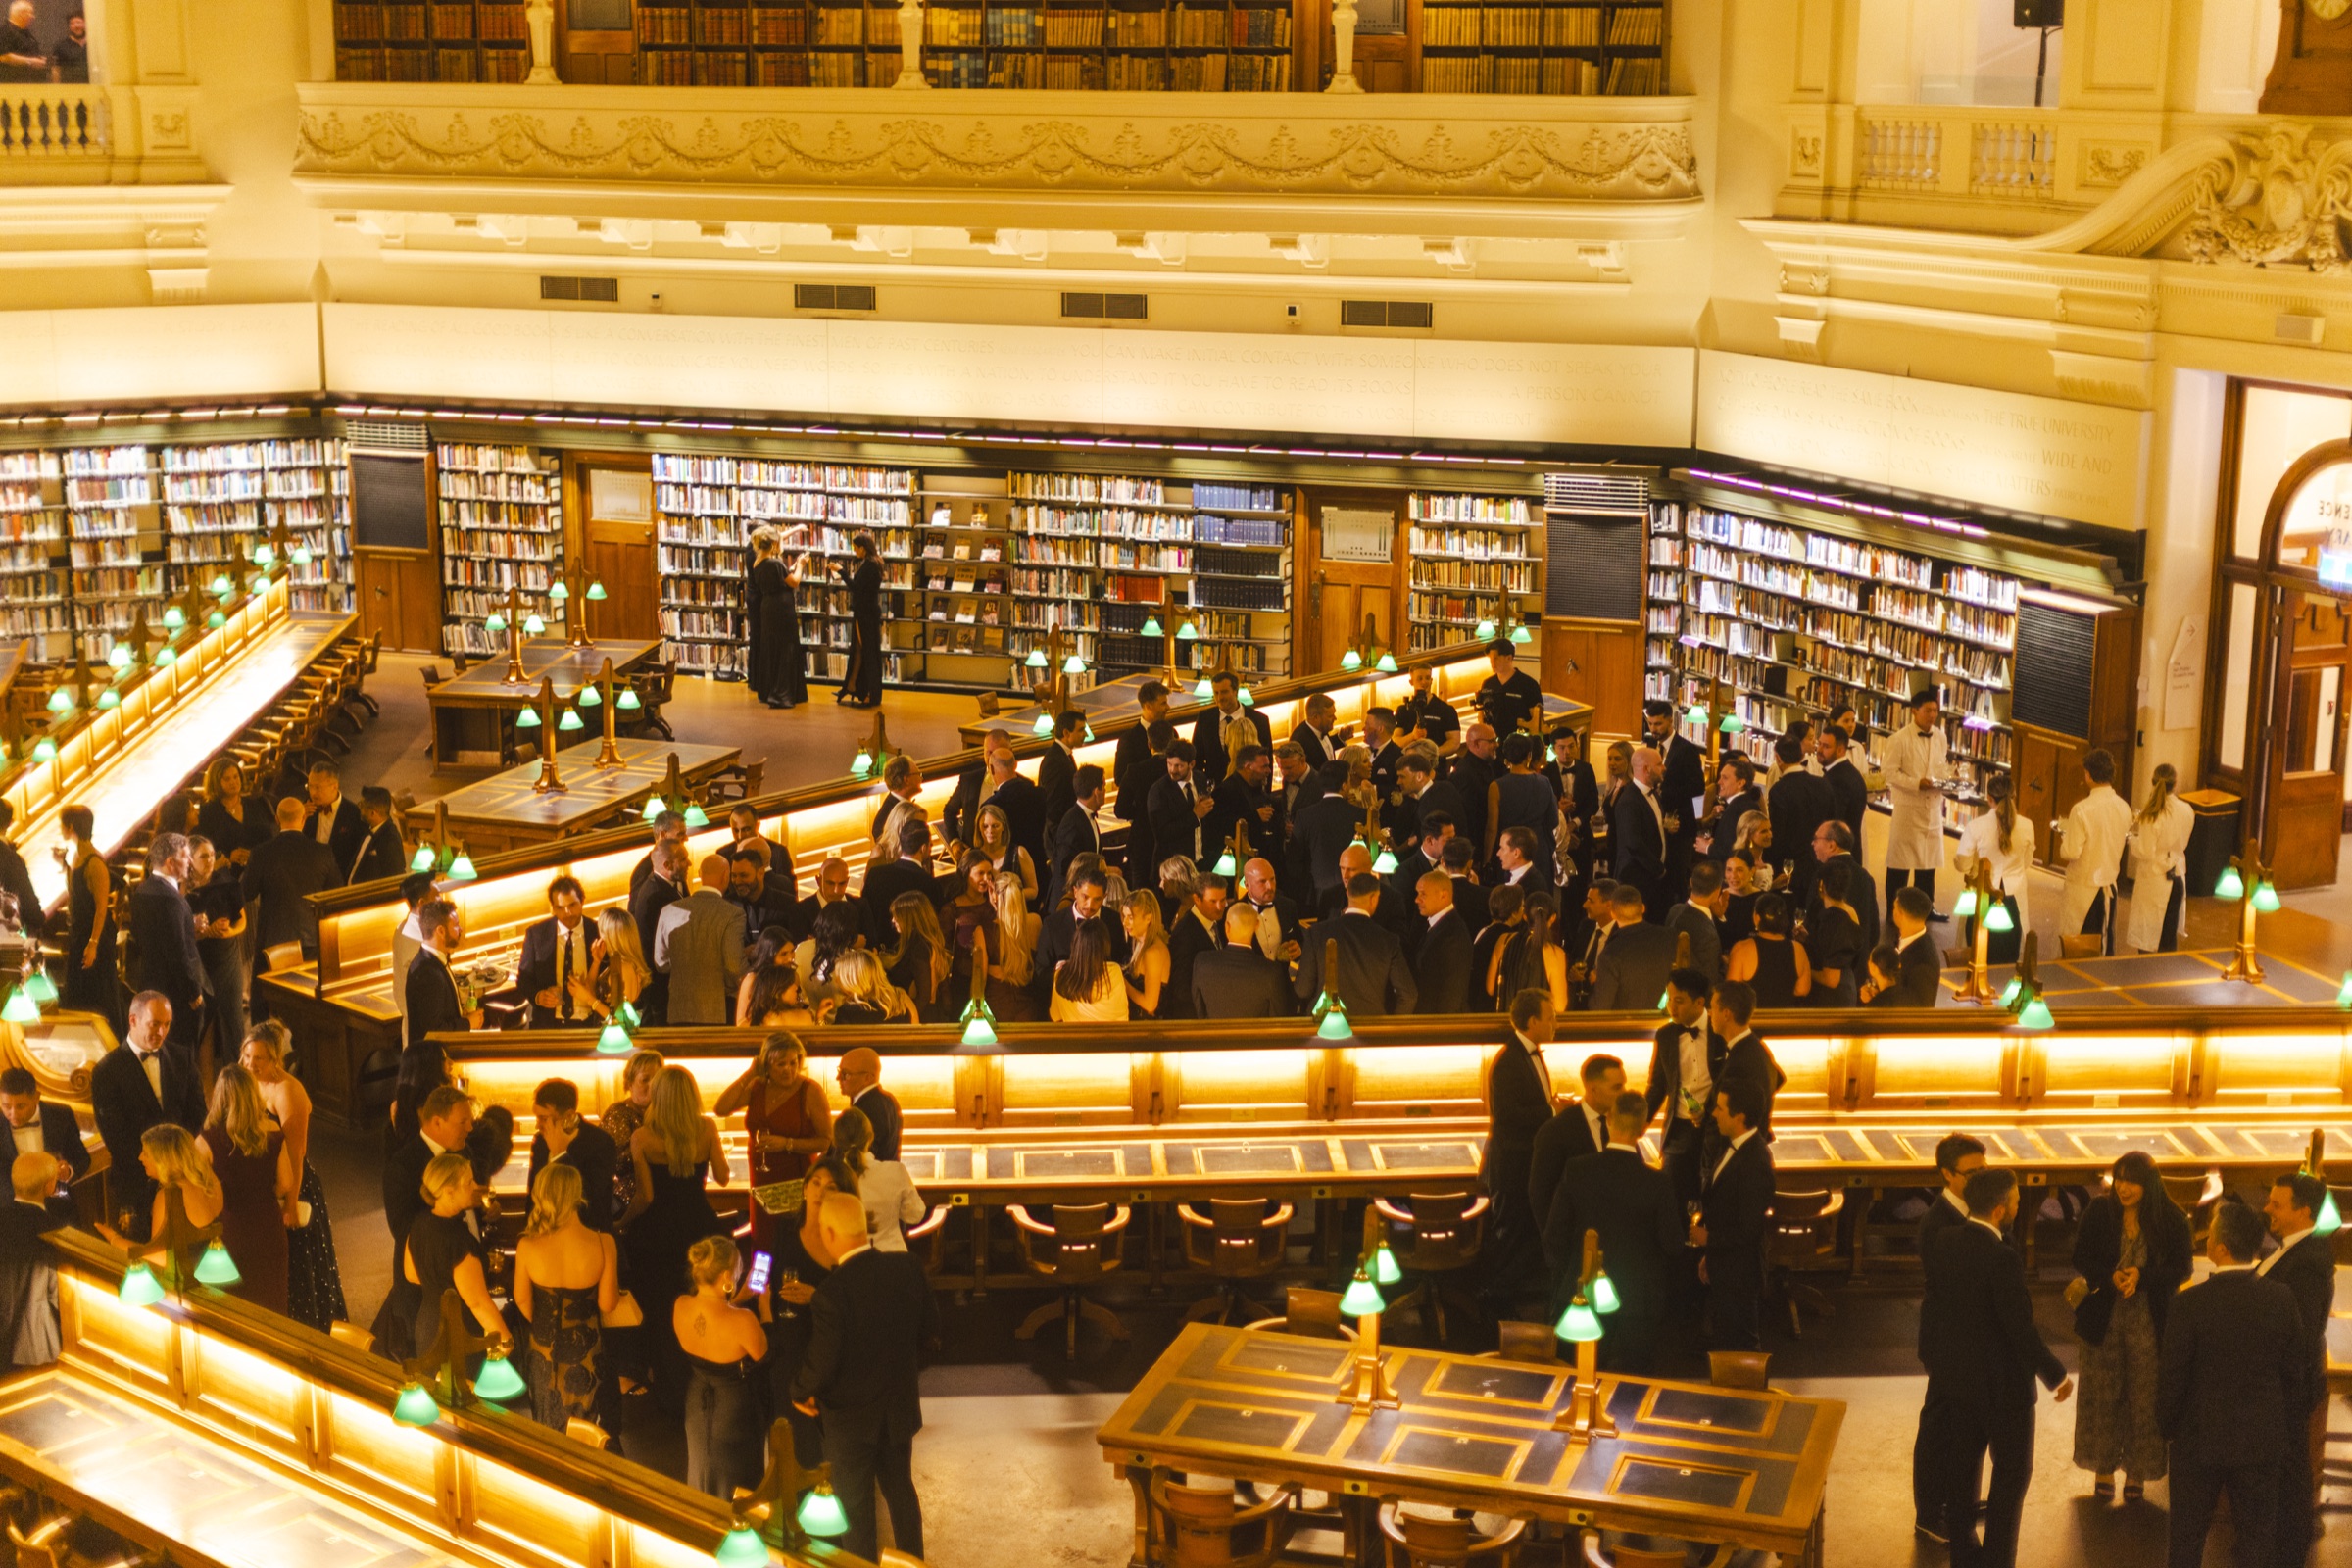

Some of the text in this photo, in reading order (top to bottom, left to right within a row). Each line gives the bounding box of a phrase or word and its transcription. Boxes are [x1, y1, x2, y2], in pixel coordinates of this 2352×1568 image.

[1982, 406, 2006, 427] THE
[2008, 410, 2039, 432] TRUE
[2041, 415, 2115, 444] UNIVERSITY
[2040, 447, 2078, 470] WIDE
[2080, 453, 2113, 476] AND
[1994, 470, 2052, 498] MATTERS
